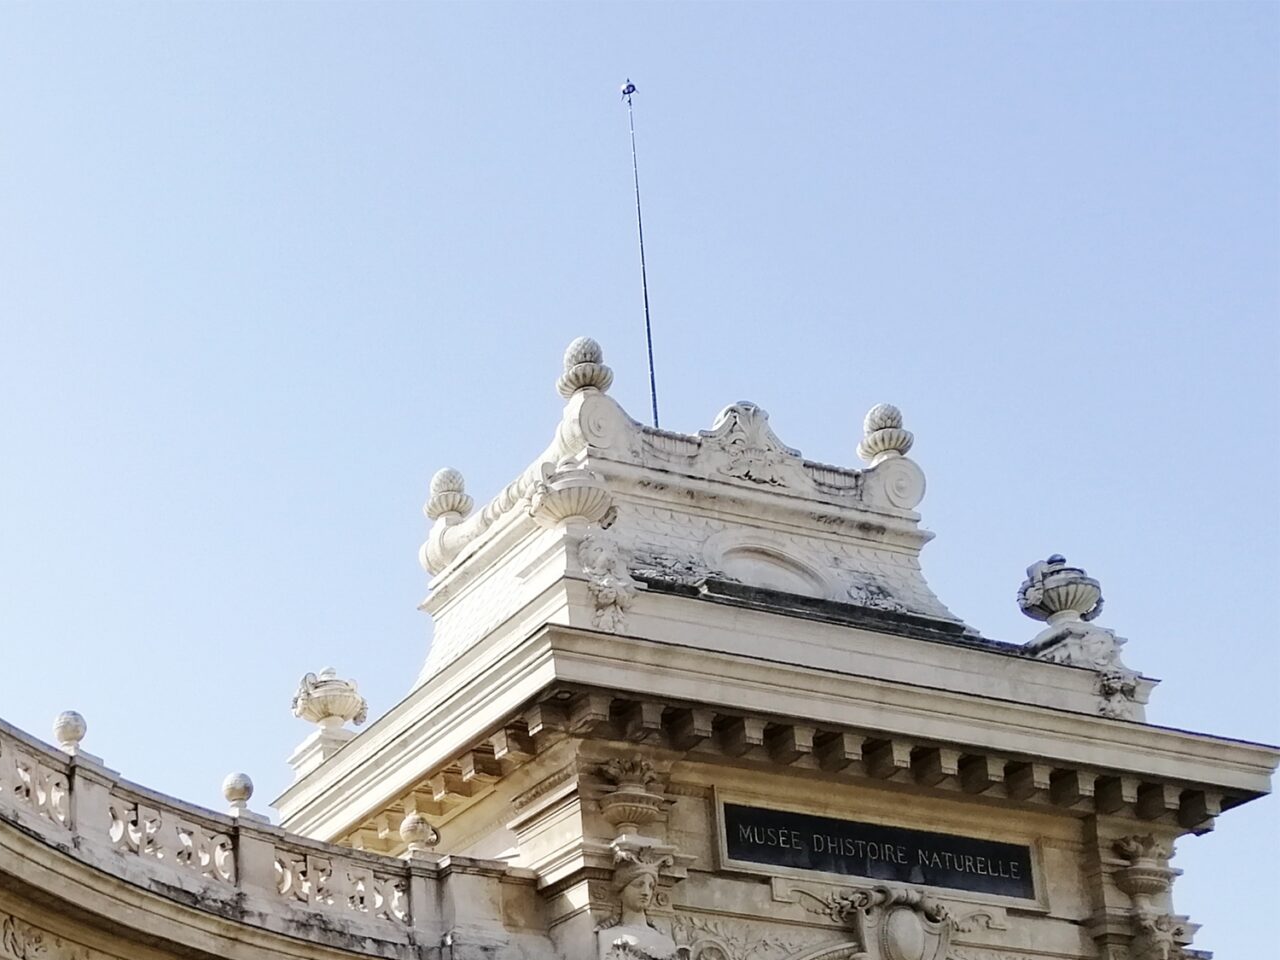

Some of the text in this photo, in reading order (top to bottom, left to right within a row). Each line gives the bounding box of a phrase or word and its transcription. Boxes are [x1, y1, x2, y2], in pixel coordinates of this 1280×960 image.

[738, 823, 1021, 880] MUSÉE D'HISTOIRE NATURELLE
